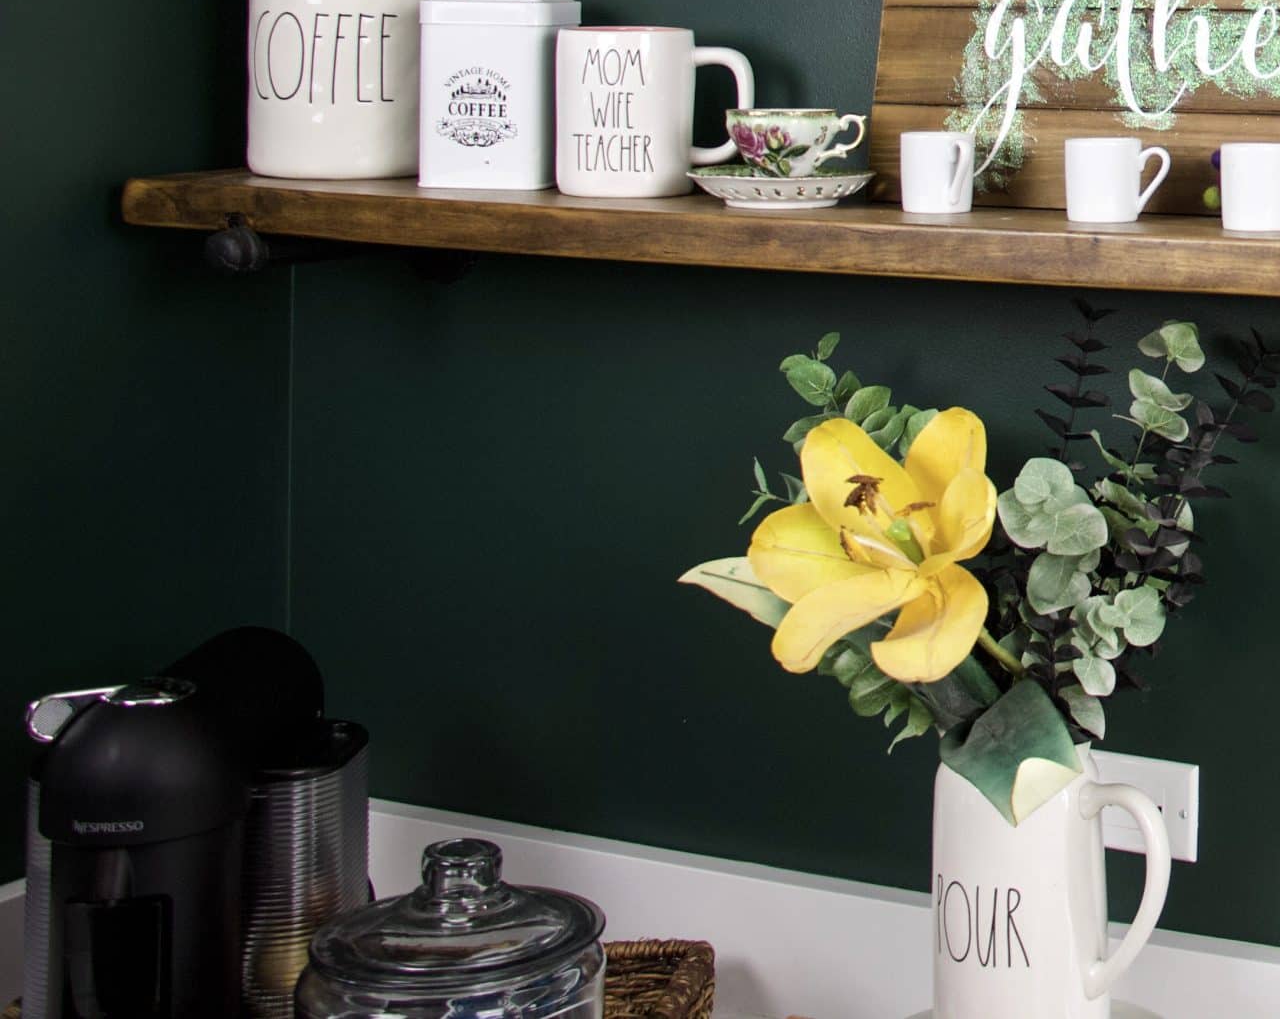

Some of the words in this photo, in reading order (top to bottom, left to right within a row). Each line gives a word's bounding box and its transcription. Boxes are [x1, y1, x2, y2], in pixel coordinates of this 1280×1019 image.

[254, 10, 398, 104] COFFEE
[582, 48, 645, 86] MOM
[443, 66, 484, 88] VINTAGE
[485, 68, 511, 90] HOME
[448, 101, 507, 118] COFFEE
[590, 90, 634, 129] WIFE
[572, 133, 654, 172] TEACHER
[73, 819, 144, 834] NESPRESSO
[937, 873, 1030, 968] POUR
